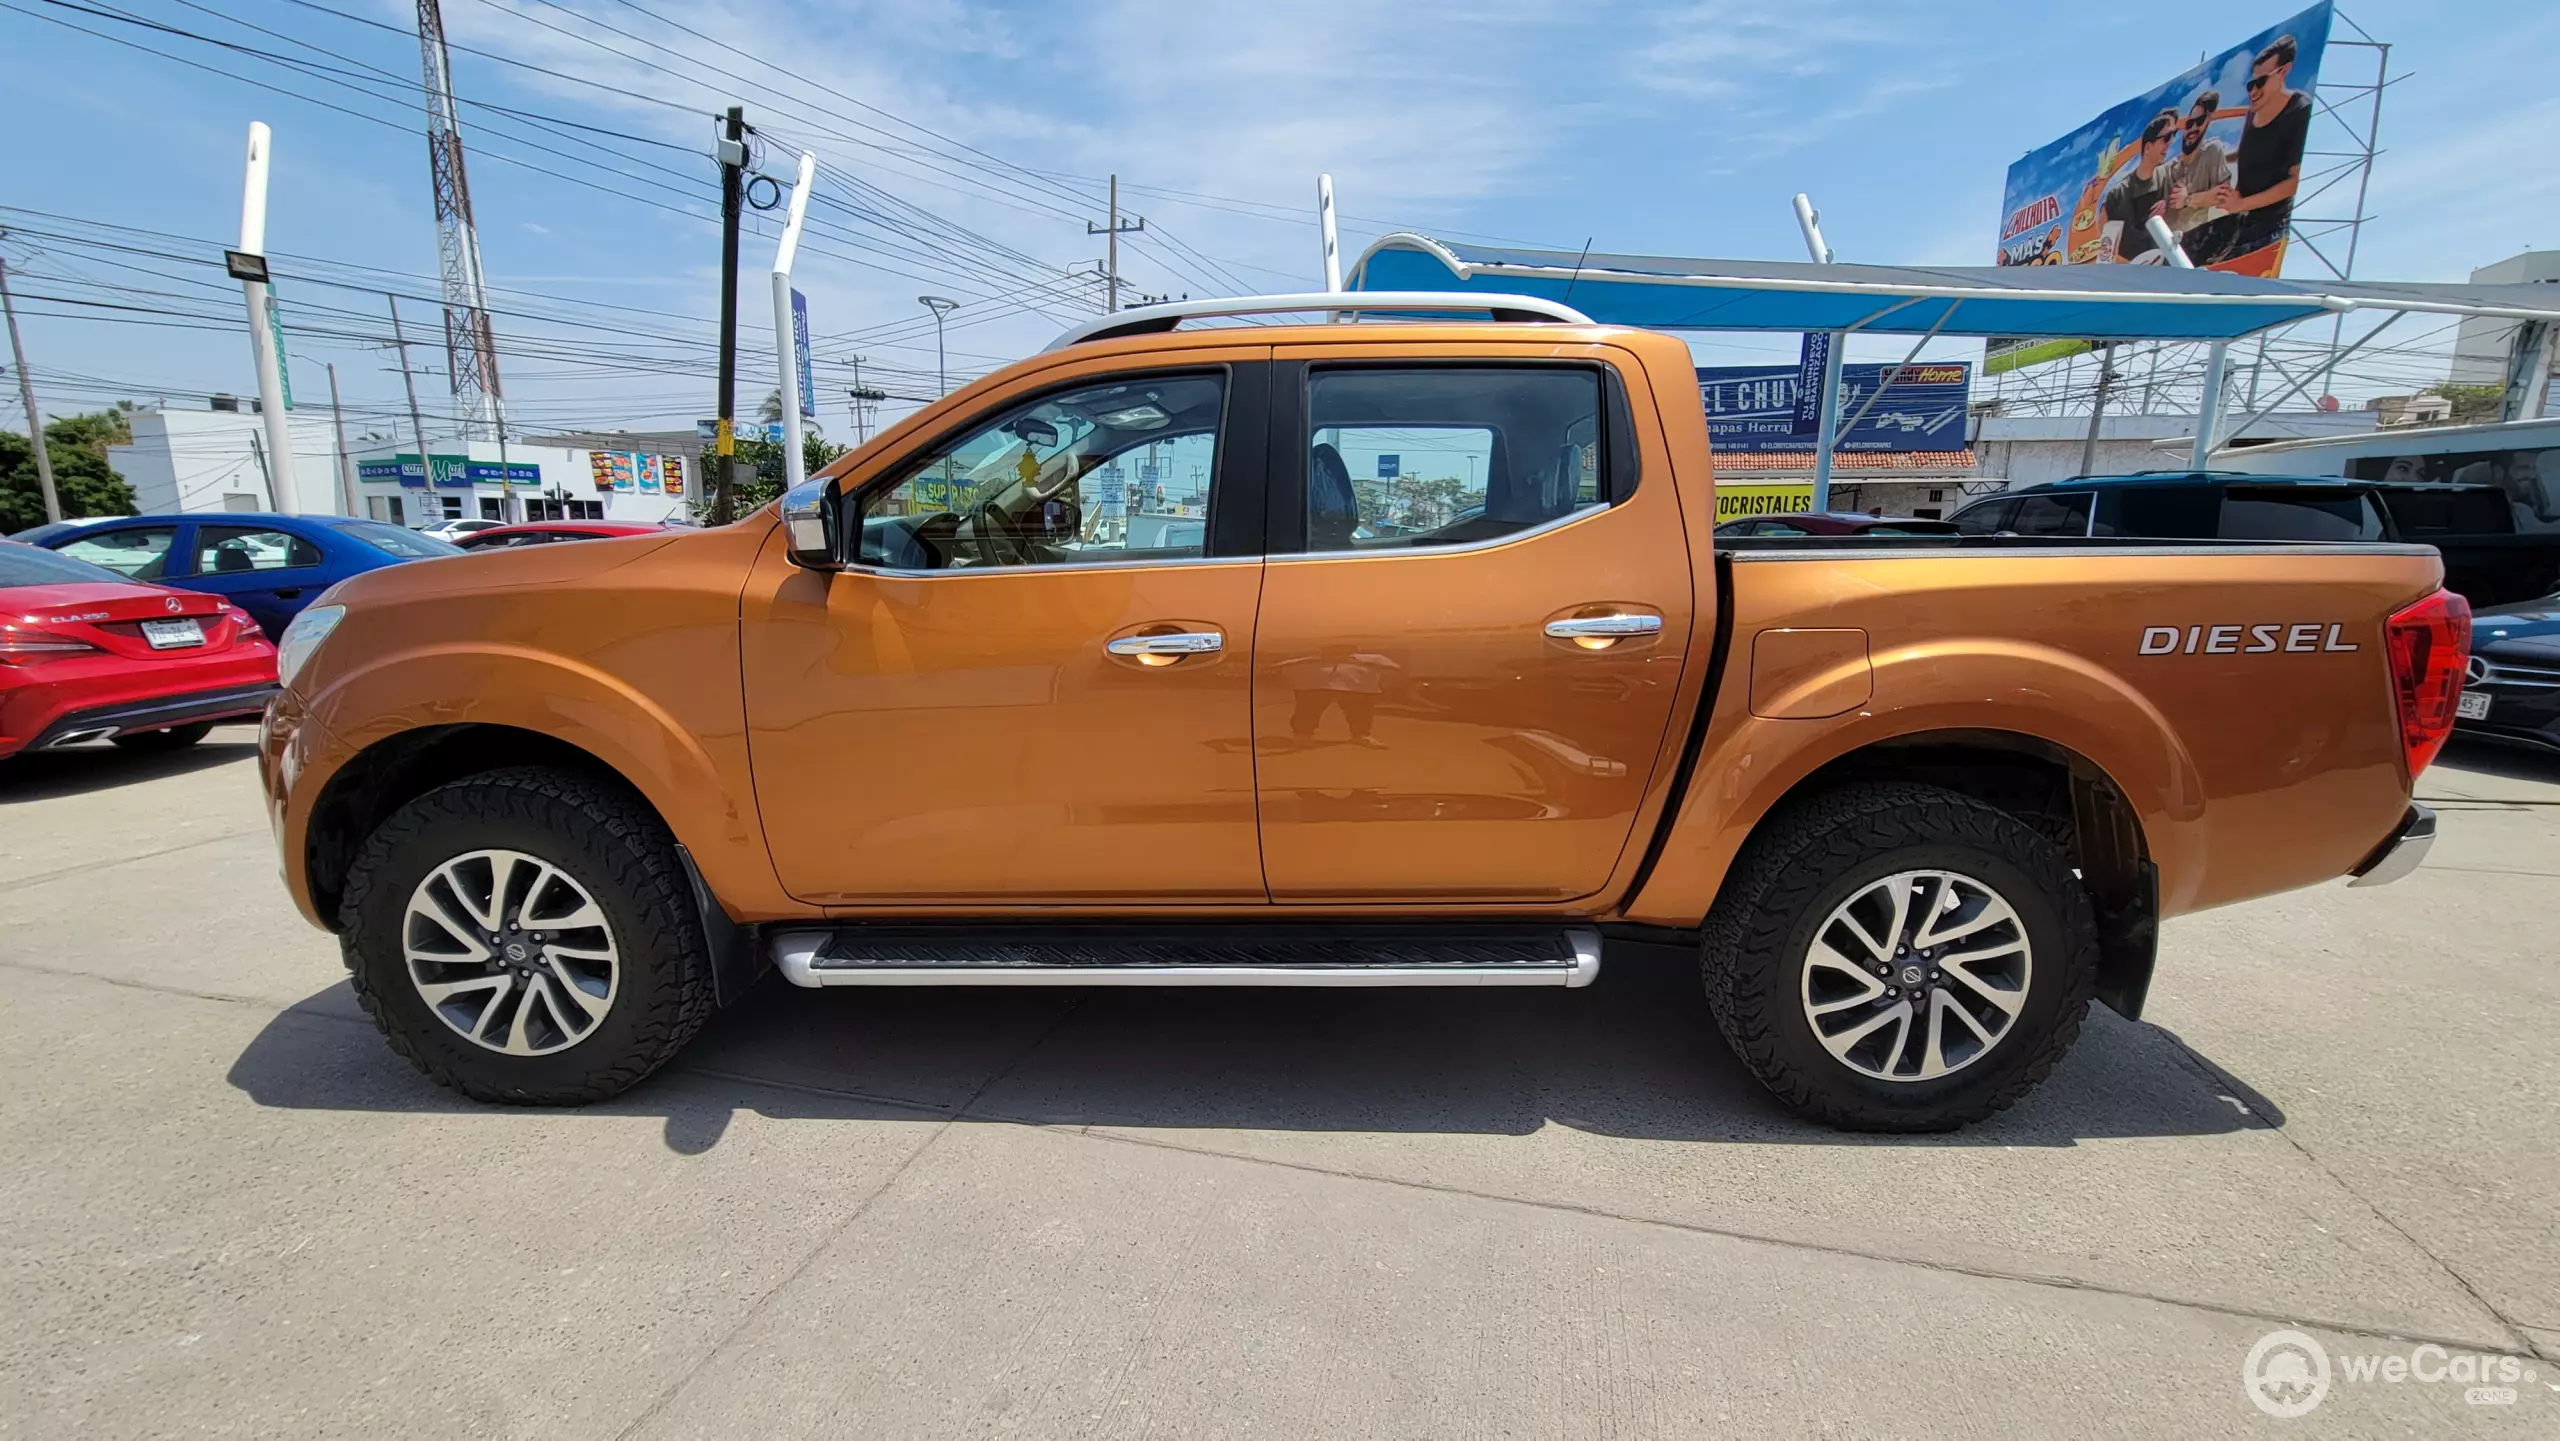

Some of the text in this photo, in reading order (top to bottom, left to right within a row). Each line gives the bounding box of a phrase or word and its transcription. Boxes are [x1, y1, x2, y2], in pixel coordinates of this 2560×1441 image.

[2003, 195, 2061, 241] CHILCHOTA
[2010, 231, 2046, 264] MÁS
[796, 343, 804, 407] ESTRENA
[1804, 333, 1818, 402] SEMINUEVO
[1738, 379, 1799, 411] CHUY
[1802, 405, 1809, 420] TU
[2138, 622, 2360, 655] DIESEL
